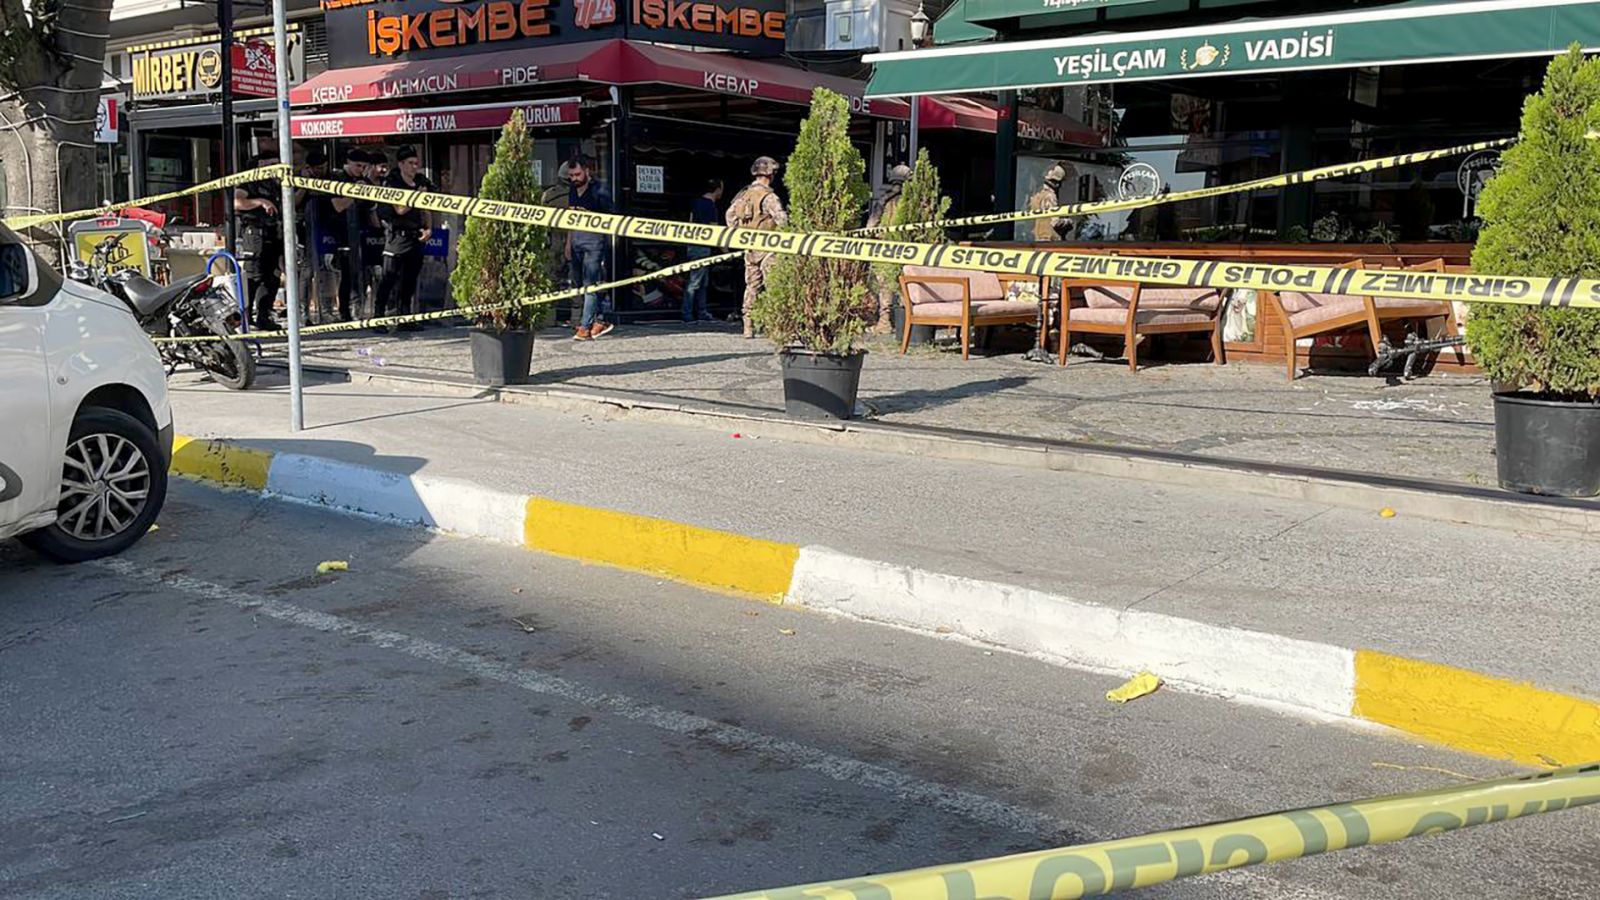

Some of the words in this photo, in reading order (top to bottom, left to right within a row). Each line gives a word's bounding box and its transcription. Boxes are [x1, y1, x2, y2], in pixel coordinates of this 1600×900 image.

[368, 0, 551, 55] İŞKEMBE
[133, 50, 196, 94] MİRBEY
[1054, 48, 1166, 79] YEŞİLÇAM
[1244, 30, 1333, 61] VADİSİ
[312, 85, 353, 103] KEBAP
[383, 74, 457, 97] LAHMACUN
[502, 66, 538, 84] PİDE
[704, 72, 758, 96] KEBAP
[301, 120, 344, 136] KOKOREÇ
[430, 115, 456, 130] TAVA
